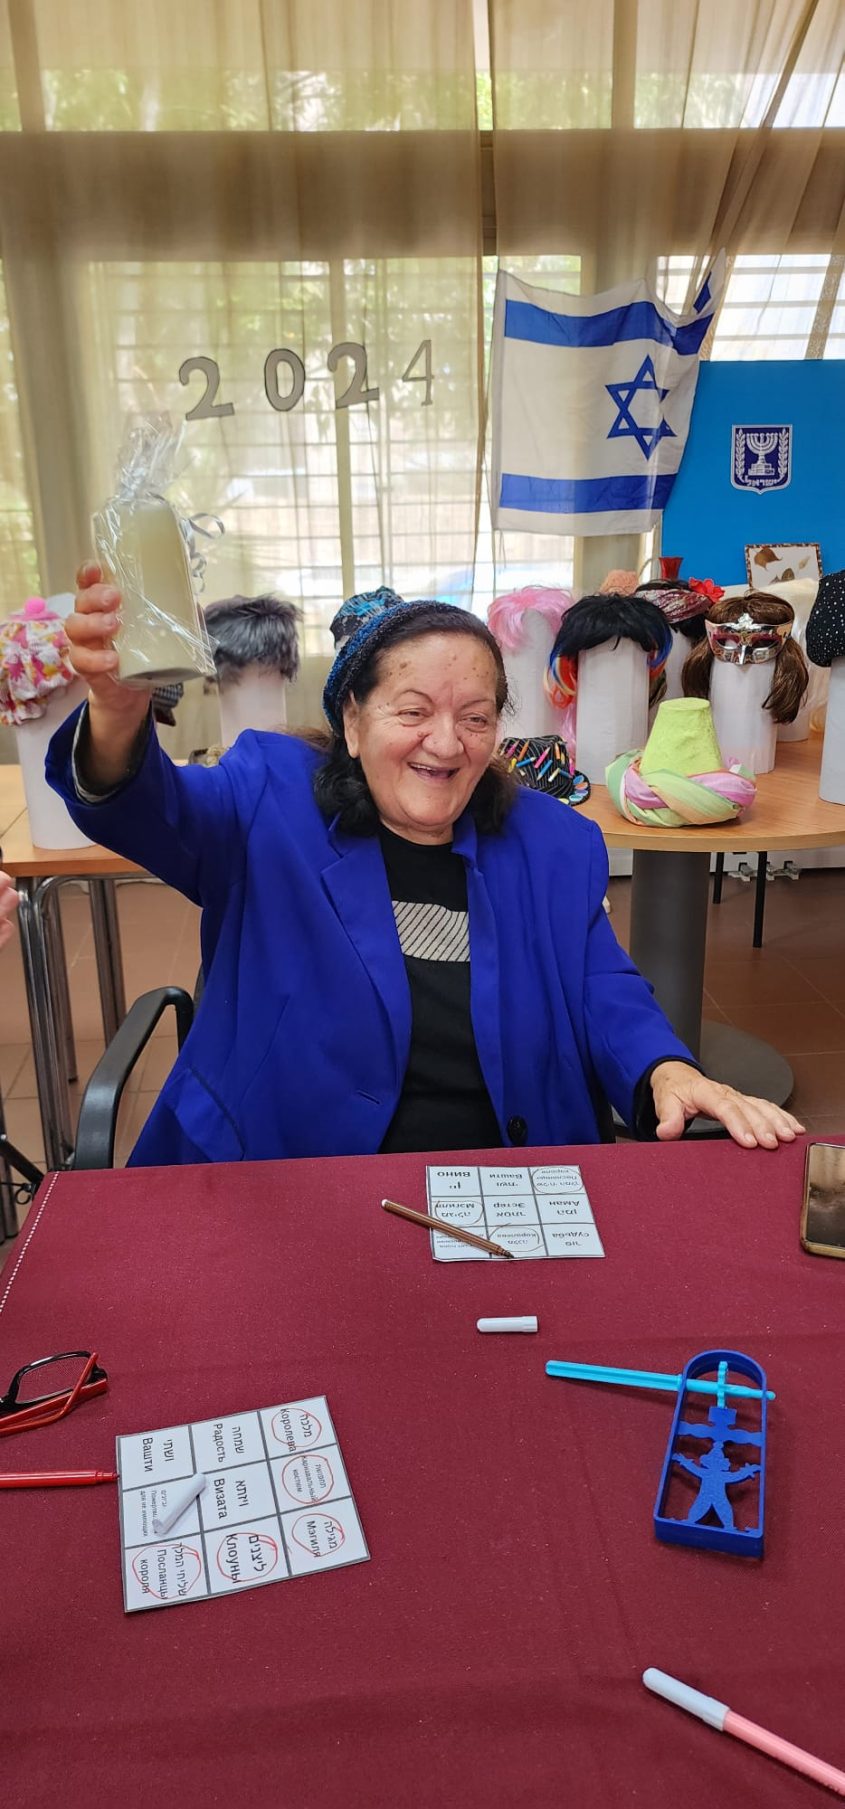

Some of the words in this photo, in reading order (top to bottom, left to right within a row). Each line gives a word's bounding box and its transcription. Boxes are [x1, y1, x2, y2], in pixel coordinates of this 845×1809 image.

[213, 1423, 226, 1463] Радость
[232, 1425, 245, 1454] שמחה
[280, 1408, 297, 1452] Королева
[300, 1412, 313, 1438] מלכה
[142, 1437, 154, 1473] Вашти
[163, 1439, 175, 1462] ושתי
[214, 1478, 228, 1519] Визата
[235, 1479, 249, 1507] ויזתא
[306, 1520, 321, 1558] Мэгиля
[324, 1520, 338, 1549] מגילה
[225, 1533, 242, 1584] Клоуны
[248, 1534, 267, 1572] ליצנים
[139, 1559, 151, 1594] короля
[156, 1549, 168, 1600] Посланцы
[176, 1569, 189, 1597] שליחי
